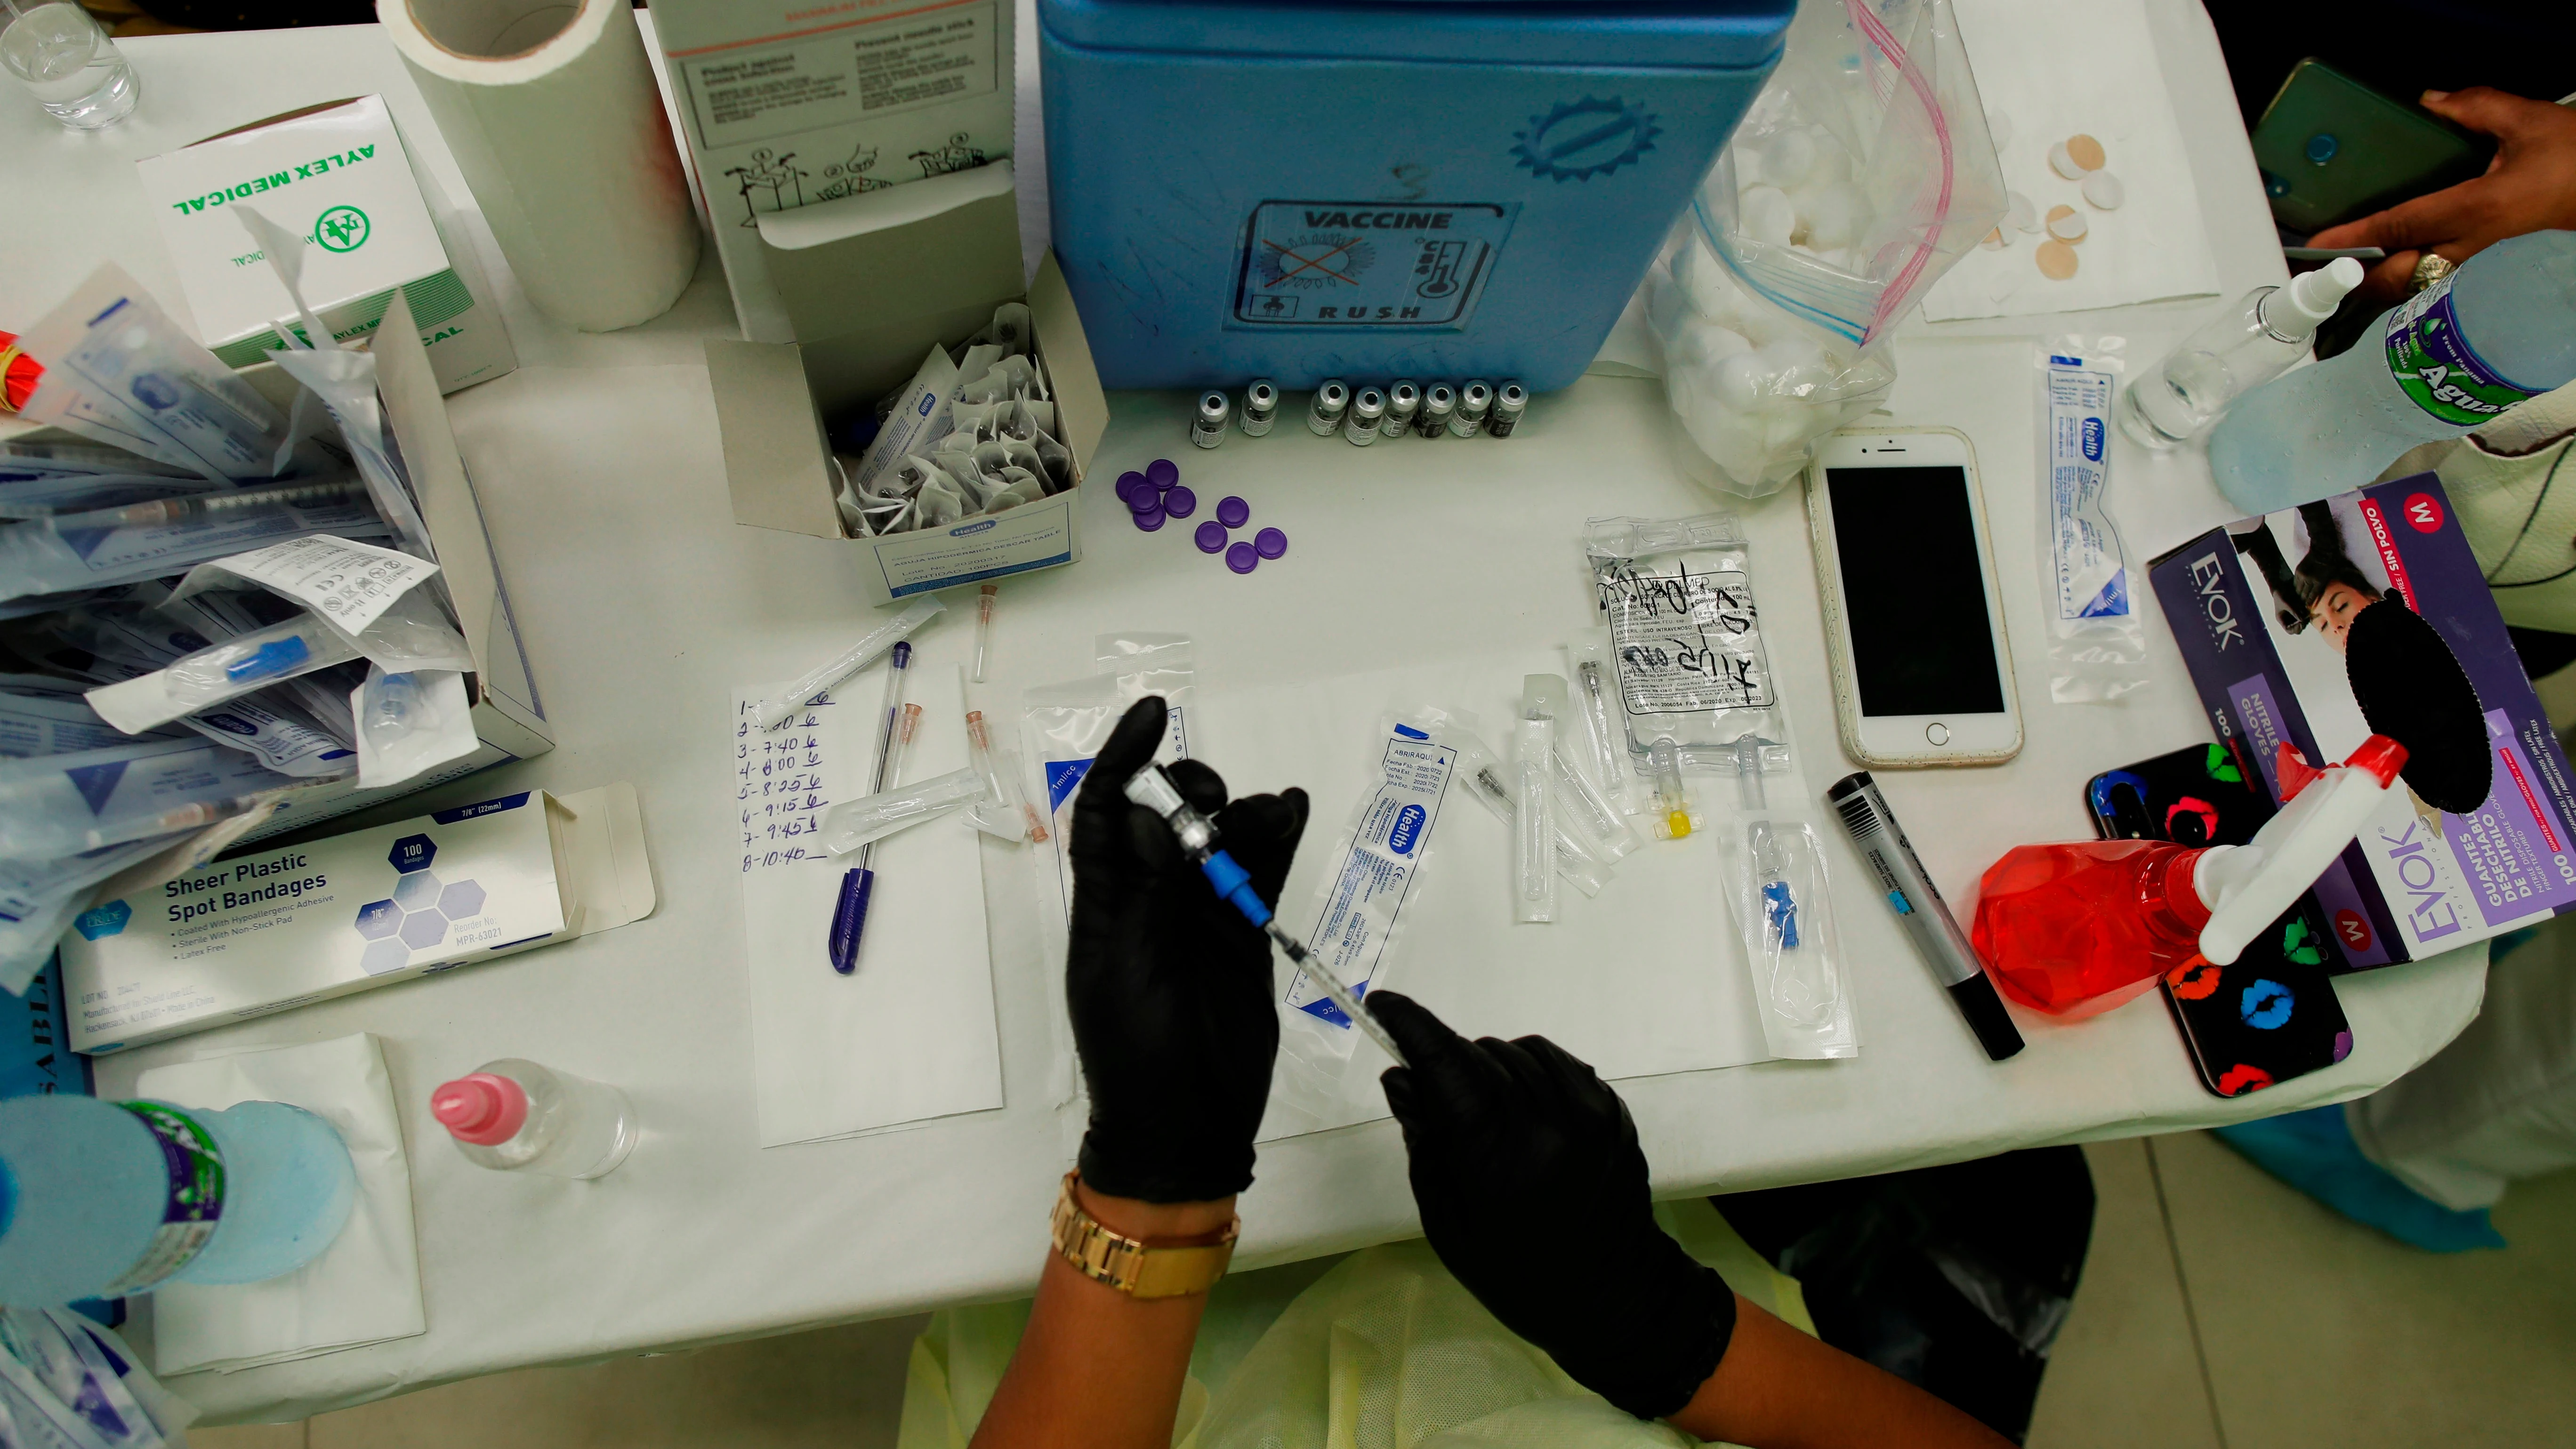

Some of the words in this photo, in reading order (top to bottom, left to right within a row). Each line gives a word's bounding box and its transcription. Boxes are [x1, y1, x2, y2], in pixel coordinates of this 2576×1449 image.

[298, 143, 376, 180] AYLEX
[172, 171, 292, 215] MEDICAL
[1305, 211, 1452, 229] VACCINE
[231, 250, 266, 267] DICAL
[1415, 266, 1429, 275] 4
[1318, 307, 1421, 319] RUSH
[333, 325, 367, 340] AYLEX
[2394, 337, 2409, 369] Purificada
[2441, 334, 2458, 358] From
[2455, 357, 2484, 385] Panama
[918, 394, 934, 414] Health
[2085, 421, 2098, 456] Health
[2410, 502, 2435, 523] M
[954, 522, 991, 536] Health
[2366, 507, 2390, 547] POLVO
[894, 558, 926, 567] AGUJA
[993, 539, 1031, 550] DESCAR
[1033, 530, 1061, 542] TABLE
[902, 568, 924, 576] Lote
[2383, 550, 2399, 572] SIN
[2190, 551, 2243, 651] EVOK
[2213, 707, 2232, 738] 100
[2239, 697, 2271, 757] GLOVES
[2250, 692, 2280, 748] NITRILE
[2529, 718, 2540, 735] LATEX
[764, 738, 798, 755] 7:40
[2523, 730, 2534, 746] LATEX
[2534, 735, 2544, 749] FREE
[2530, 745, 2539, 756] SIN
[1052, 765, 1076, 790] 1ml/cc
[2538, 758, 2561, 797] AMBIDIESTROS
[2544, 751, 2568, 791] AMBIDEXTROUS
[477, 801, 502, 813] (22mm)
[765, 797, 800, 817] 9:15
[2566, 794, 2576, 808] ONLY
[1373, 809, 1381, 820] sólo
[767, 817, 807, 839] 9:45
[1374, 813, 1390, 844] Hipodérmica
[1391, 806, 1420, 849] Health
[2540, 823, 2558, 852] GUANTES
[402, 843, 423, 857] 100
[2481, 812, 2520, 874] NITRILO
[2502, 820, 2529, 865] DISPOSABLE
[2517, 829, 2539, 865] TEXTURED
[403, 855, 425, 865] Bandages
[1868, 851, 1884, 875] SURFACES
[1874, 848, 1886, 865] SURFACES
[163, 869, 232, 898] Sheer
[234, 850, 309, 883] Plastic
[1393, 865, 1406, 880] CE
[2457, 831, 2504, 908] GUANTES
[2527, 866, 2545, 893] NITRILE
[2535, 864, 2552, 891] FINGER
[2553, 854, 2576, 886] 100
[1388, 878, 1397, 891] 0123
[2380, 821, 2462, 943] EVOK
[2513, 876, 2533, 898] DE
[166, 896, 219, 926] Spot
[221, 870, 329, 913] Bandages
[1362, 884, 1374, 903] empaque
[177, 923, 209, 937] Coated
[209, 918, 230, 929] With
[231, 902, 295, 925] Hypoallergenic
[296, 893, 335, 909] Adhesive
[453, 919, 483, 933] Reorder
[483, 915, 498, 926] No:
[178, 935, 208, 948] Sterile
[209, 930, 230, 941] With
[230, 919, 274, 935] Non-Stick
[275, 915, 293, 926] Pad
[455, 927, 503, 947] MPR-63021
[1360, 931, 1369, 942] Con
[2342, 921, 2364, 942] M
[180, 948, 205, 960] Latex
[206, 942, 226, 954] Free
[1333, 950, 1344, 966] J-026
[1343, 940, 1357, 966] 0.45x9.5mm
[1353, 941, 1364, 958] Aguja
